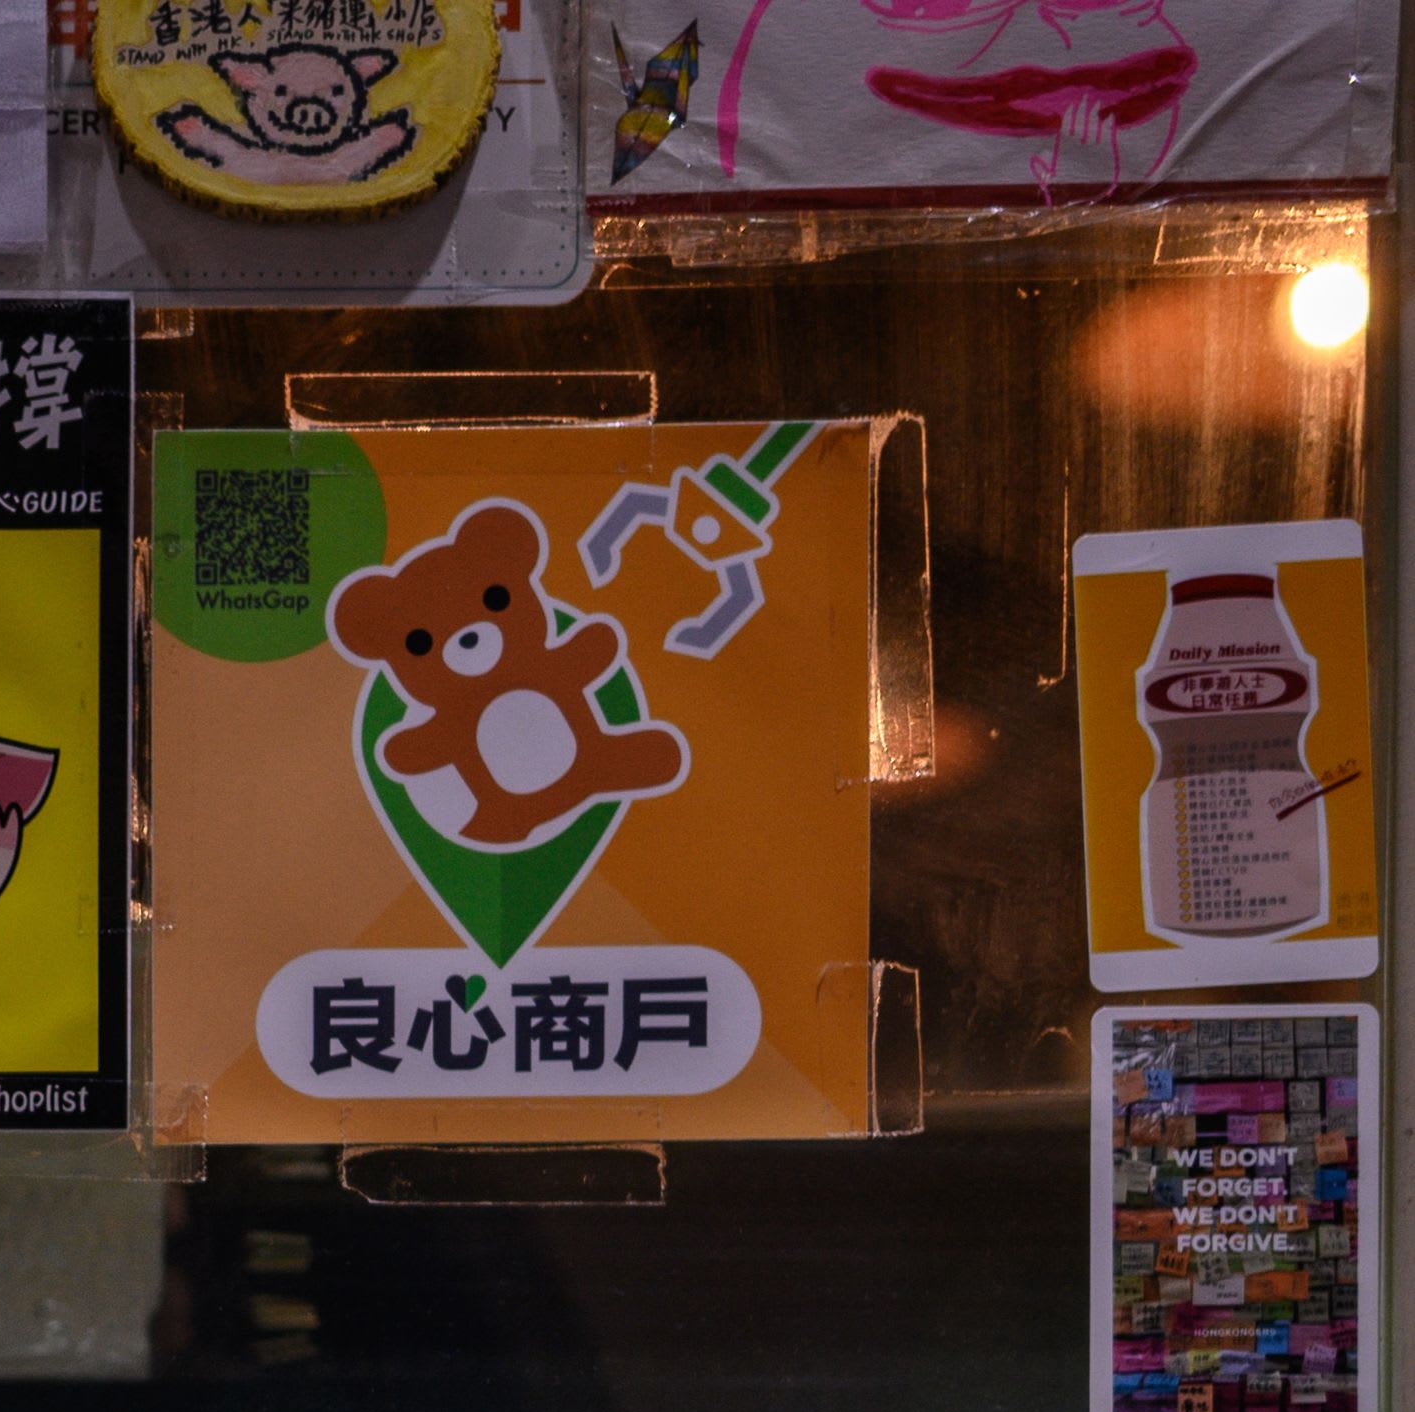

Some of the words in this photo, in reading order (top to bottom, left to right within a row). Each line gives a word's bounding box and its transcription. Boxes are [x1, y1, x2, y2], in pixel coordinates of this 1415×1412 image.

[195, 589, 311, 615] WhatsGap
[1170, 647, 1212, 663] Daily
[1218, 643, 1281, 658] Mission
[309, 975, 708, 1075] 良心商戶
[1171, 1149, 1214, 1168] WE
[1220, 1147, 1298, 1168] DON'T
[1182, 1177, 1288, 1197] FORGET.
[1171, 1206, 1214, 1225] WE
[1220, 1205, 1298, 1224] DON'T
[1177, 1233, 1294, 1253] FORGIVE.
